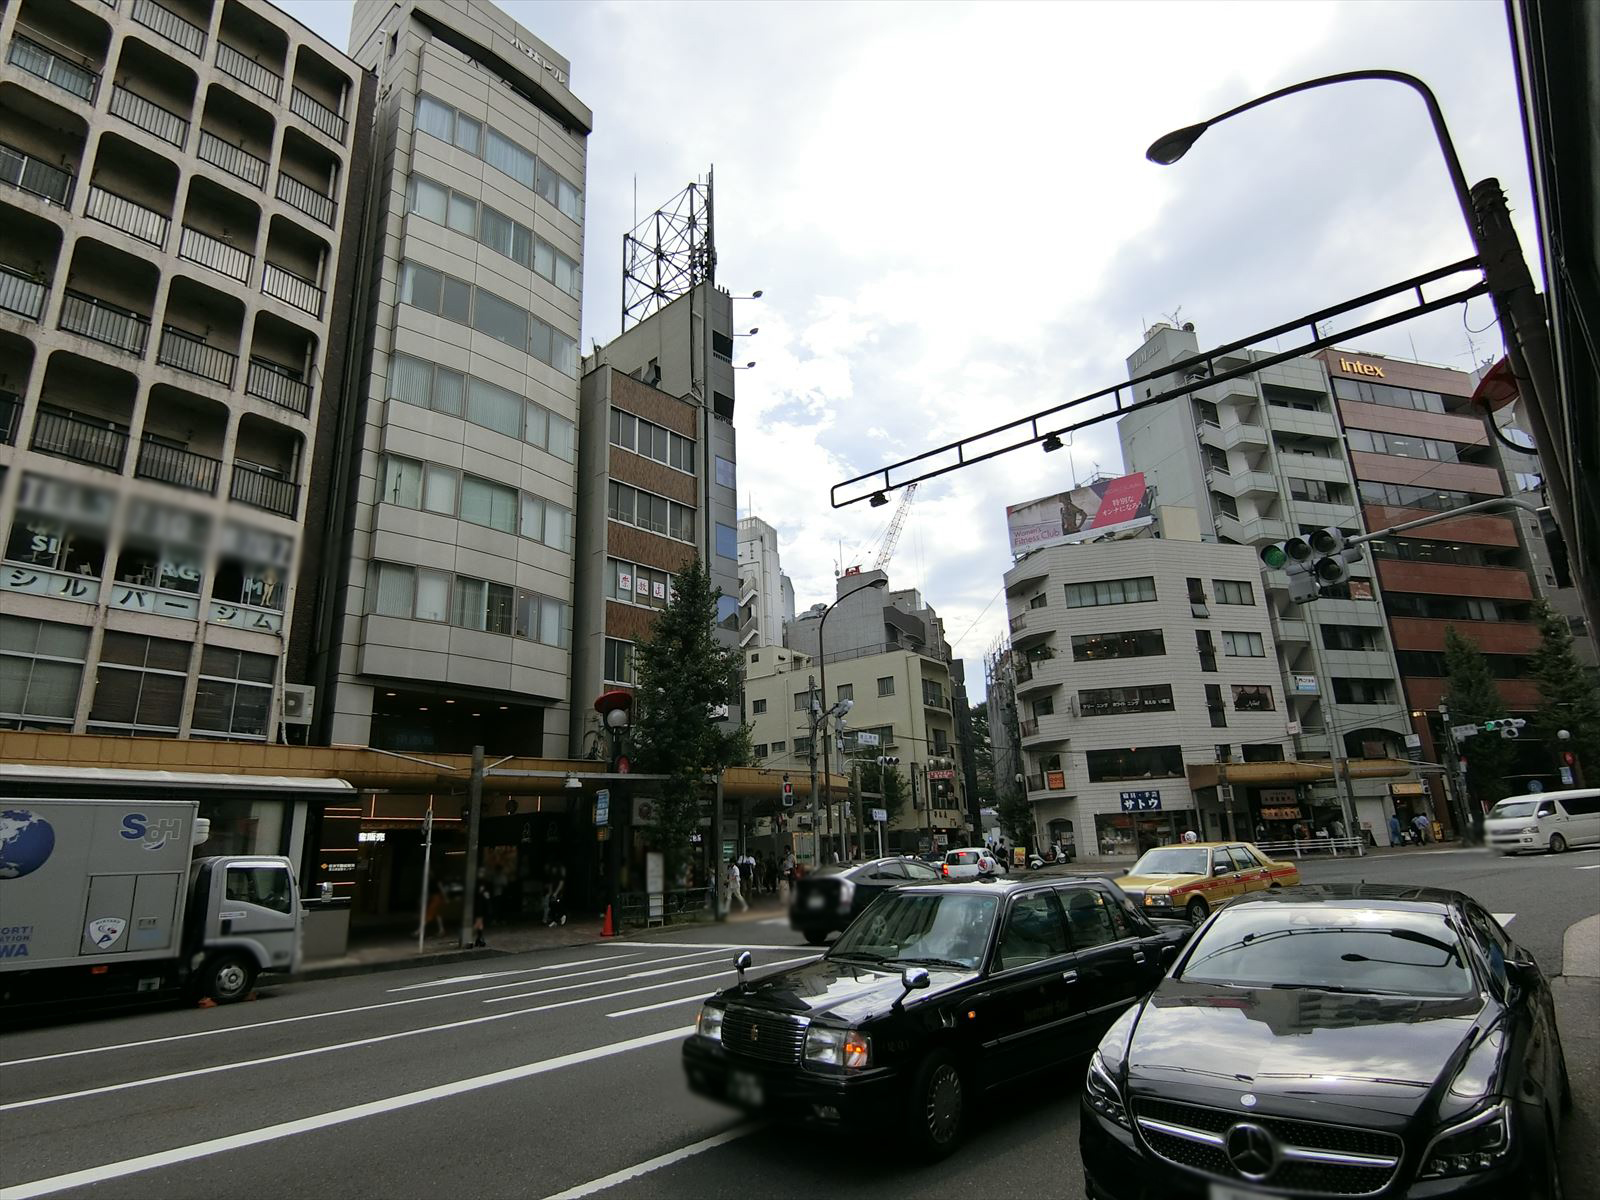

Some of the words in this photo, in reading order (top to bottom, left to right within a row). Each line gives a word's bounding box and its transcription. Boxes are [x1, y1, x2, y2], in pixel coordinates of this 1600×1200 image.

[1340, 357, 1385, 378] Intex
[1014, 535, 1040, 545] Fitness
[1041, 527, 1060, 539] Club
[1123, 798, 1159, 810] サトウ
